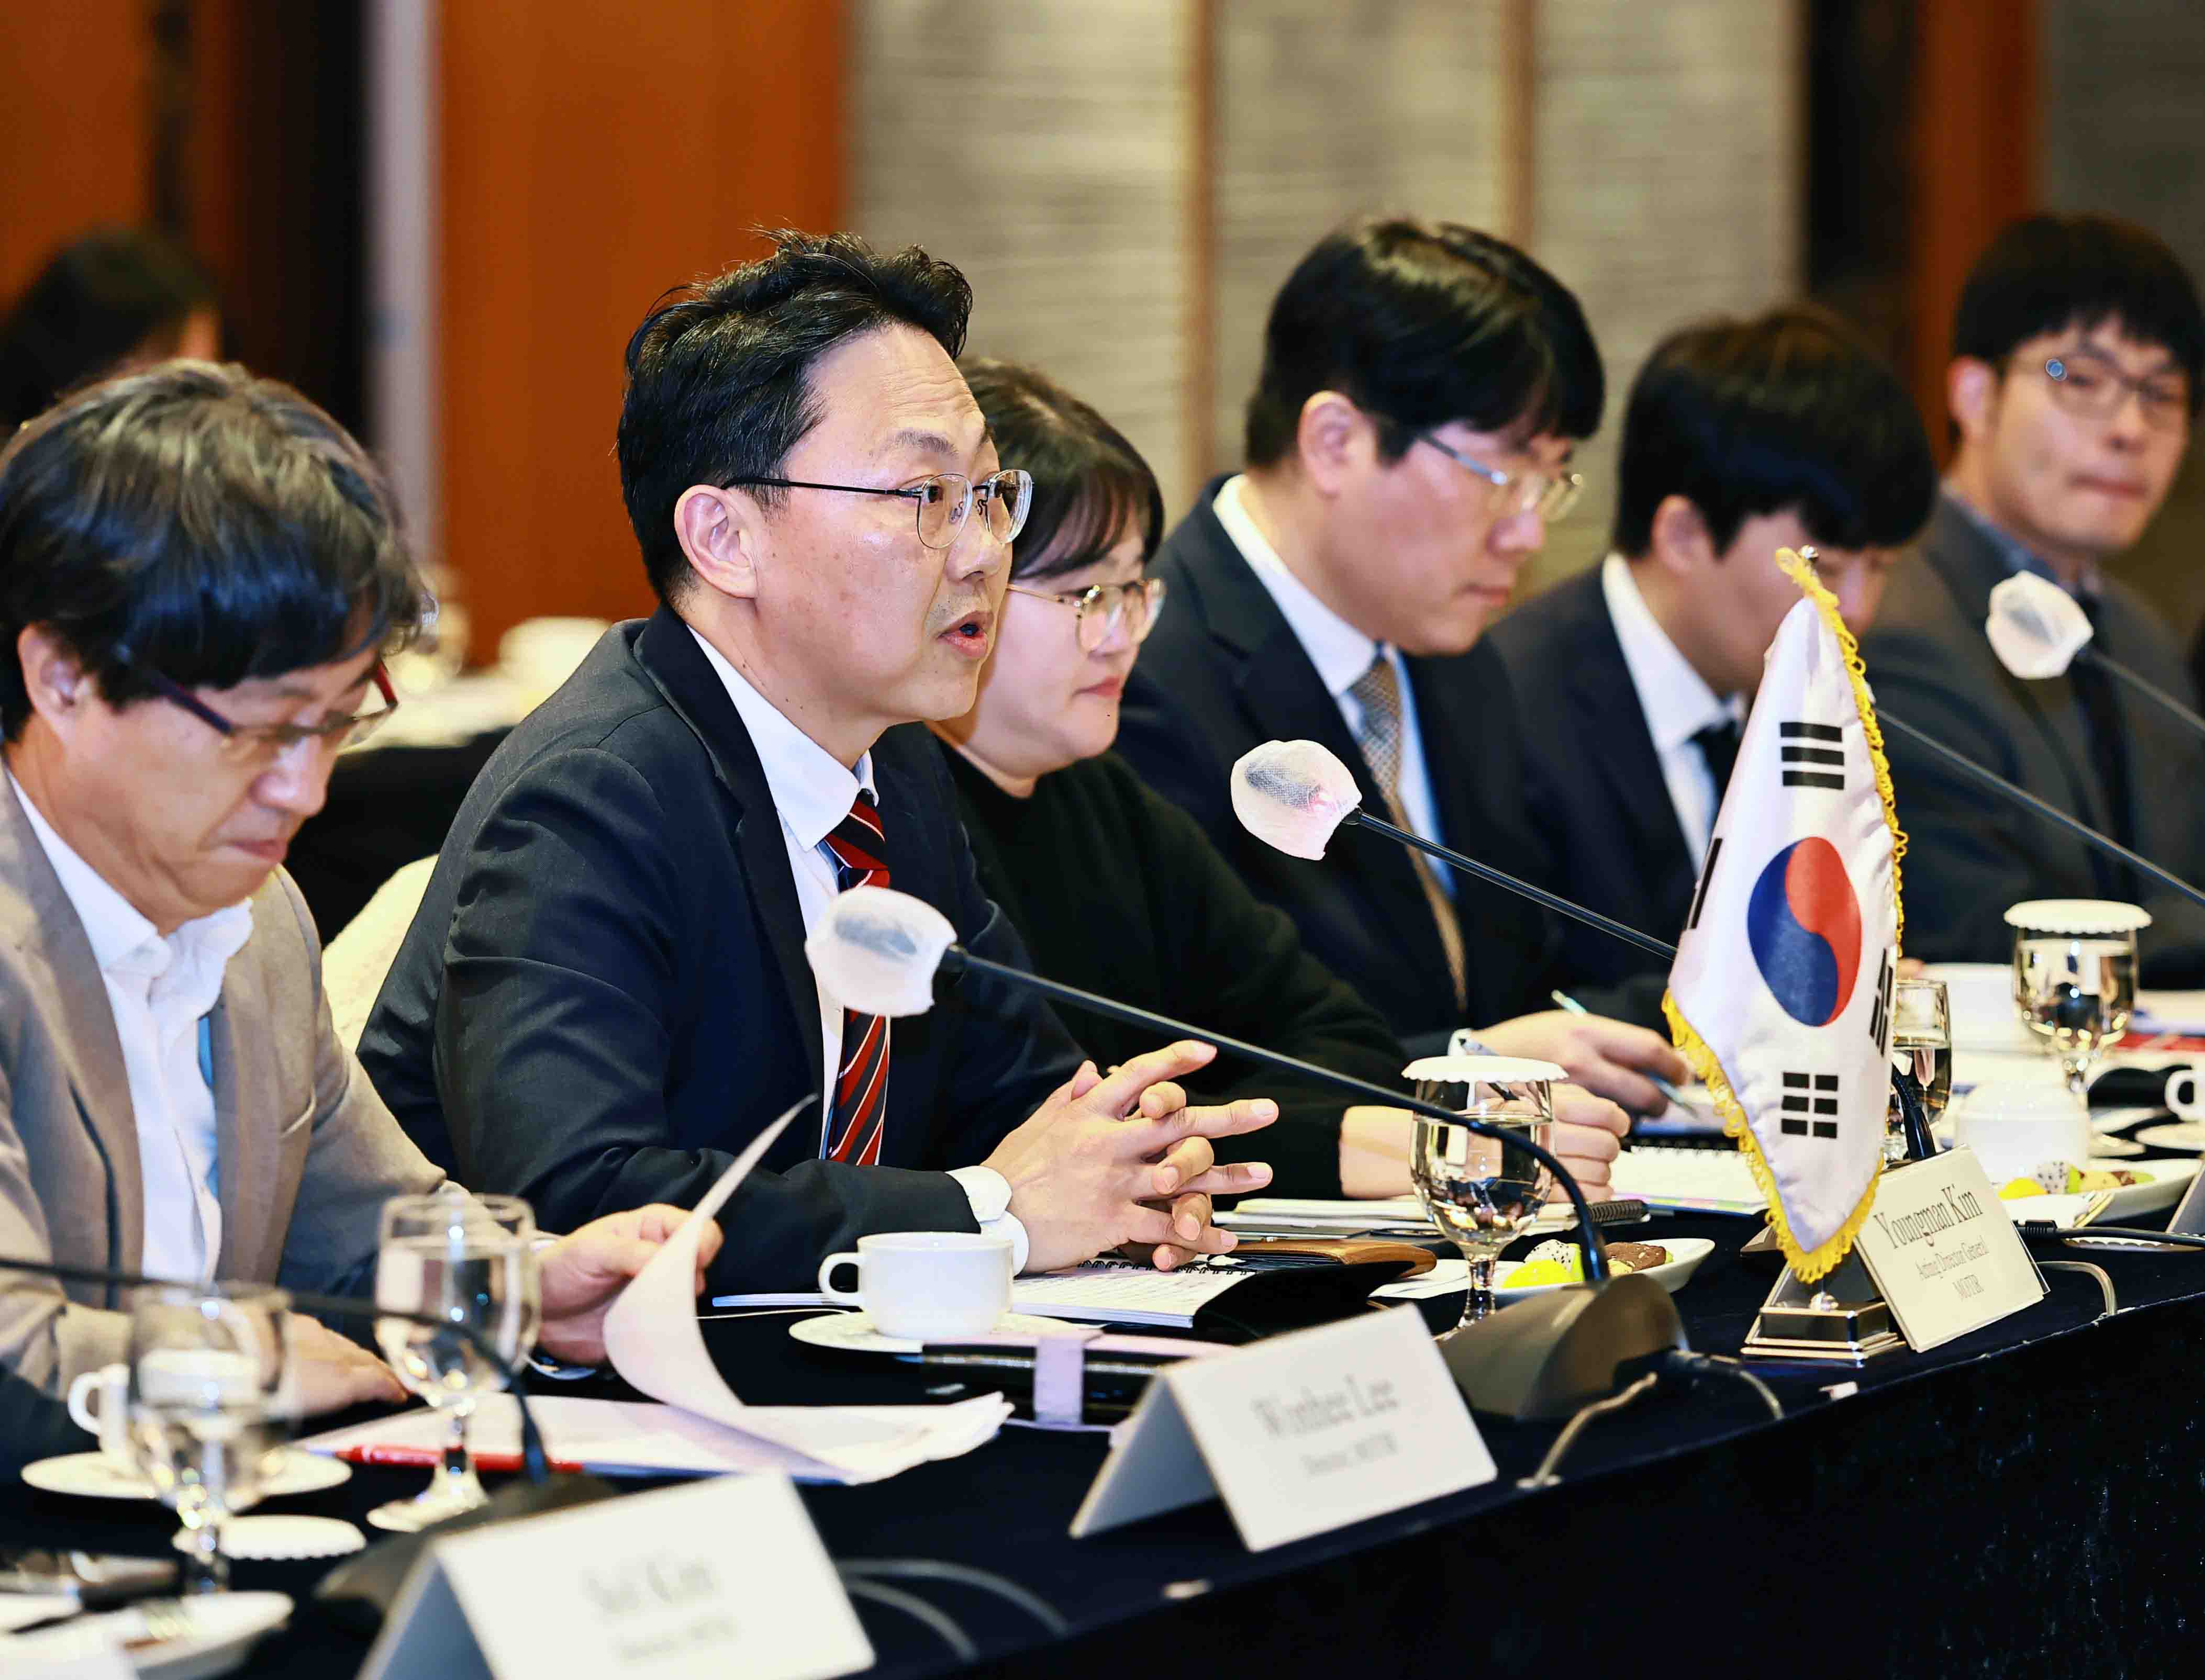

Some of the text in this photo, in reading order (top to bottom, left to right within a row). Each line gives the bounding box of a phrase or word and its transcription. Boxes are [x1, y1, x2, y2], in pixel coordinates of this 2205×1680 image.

[1873, 1183, 1984, 1249] Youngman Kim
[1935, 1249, 1967, 1271] Director
[1961, 1235, 1990, 1261] General
